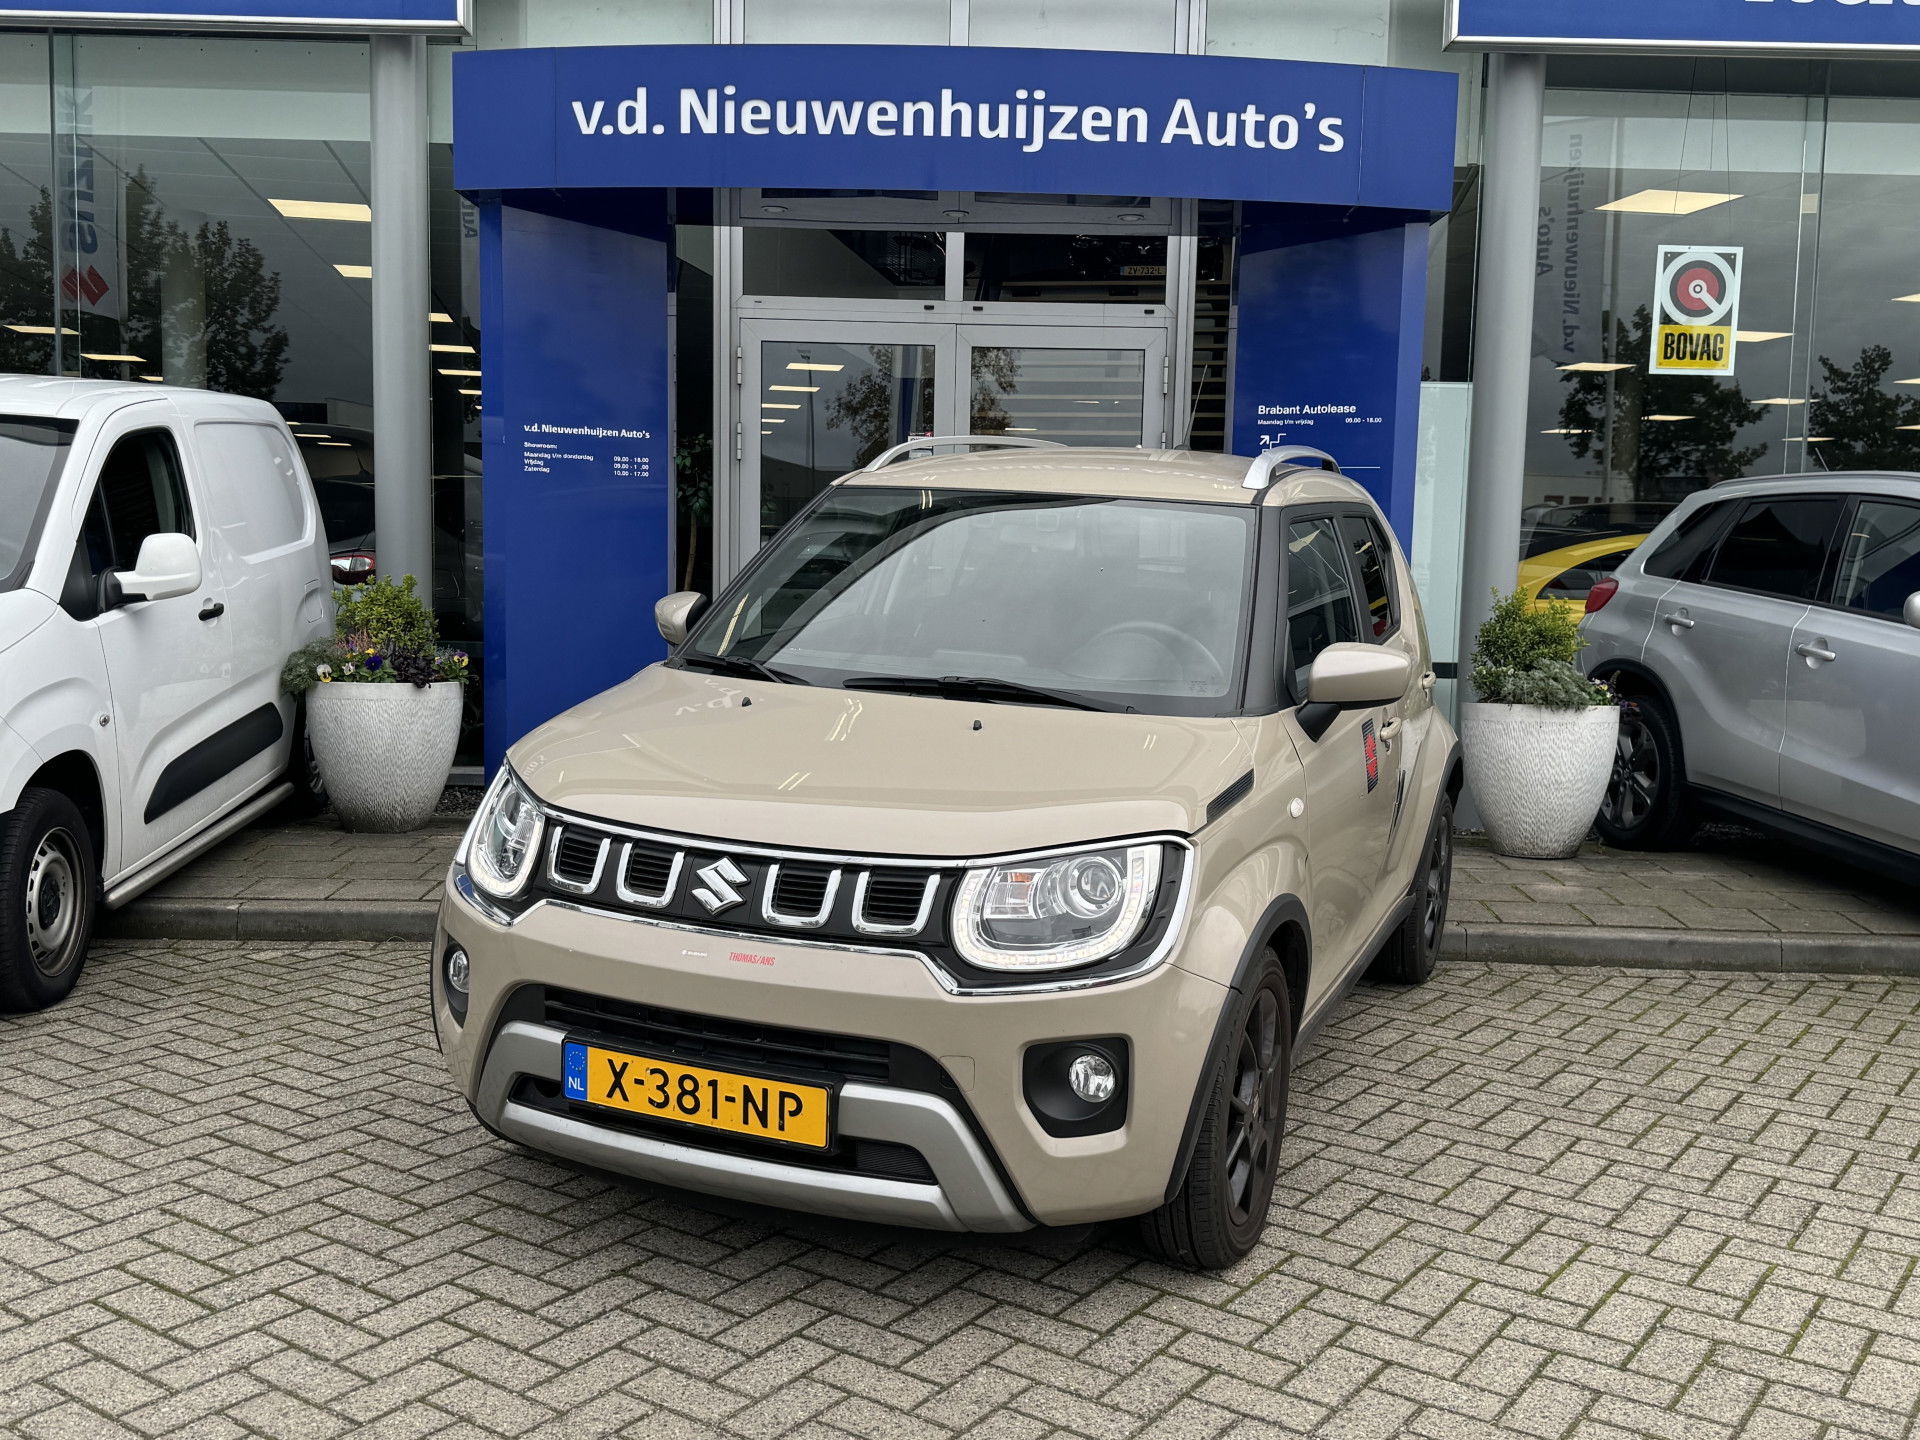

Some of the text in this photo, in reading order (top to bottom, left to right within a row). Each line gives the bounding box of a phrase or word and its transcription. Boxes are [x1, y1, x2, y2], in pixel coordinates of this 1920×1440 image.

[571, 85, 1345, 153] v.d. Nieuwenhuijzen Auto's
[1663, 332, 1725, 361] BOVAG
[1258, 404, 1357, 415] Brabant Autolease
[524, 423, 650, 439] v.d. Nieuwenhuijzen Auto's
[568, 1075, 585, 1092] NL
[606, 1058, 804, 1132] X-381-NP
